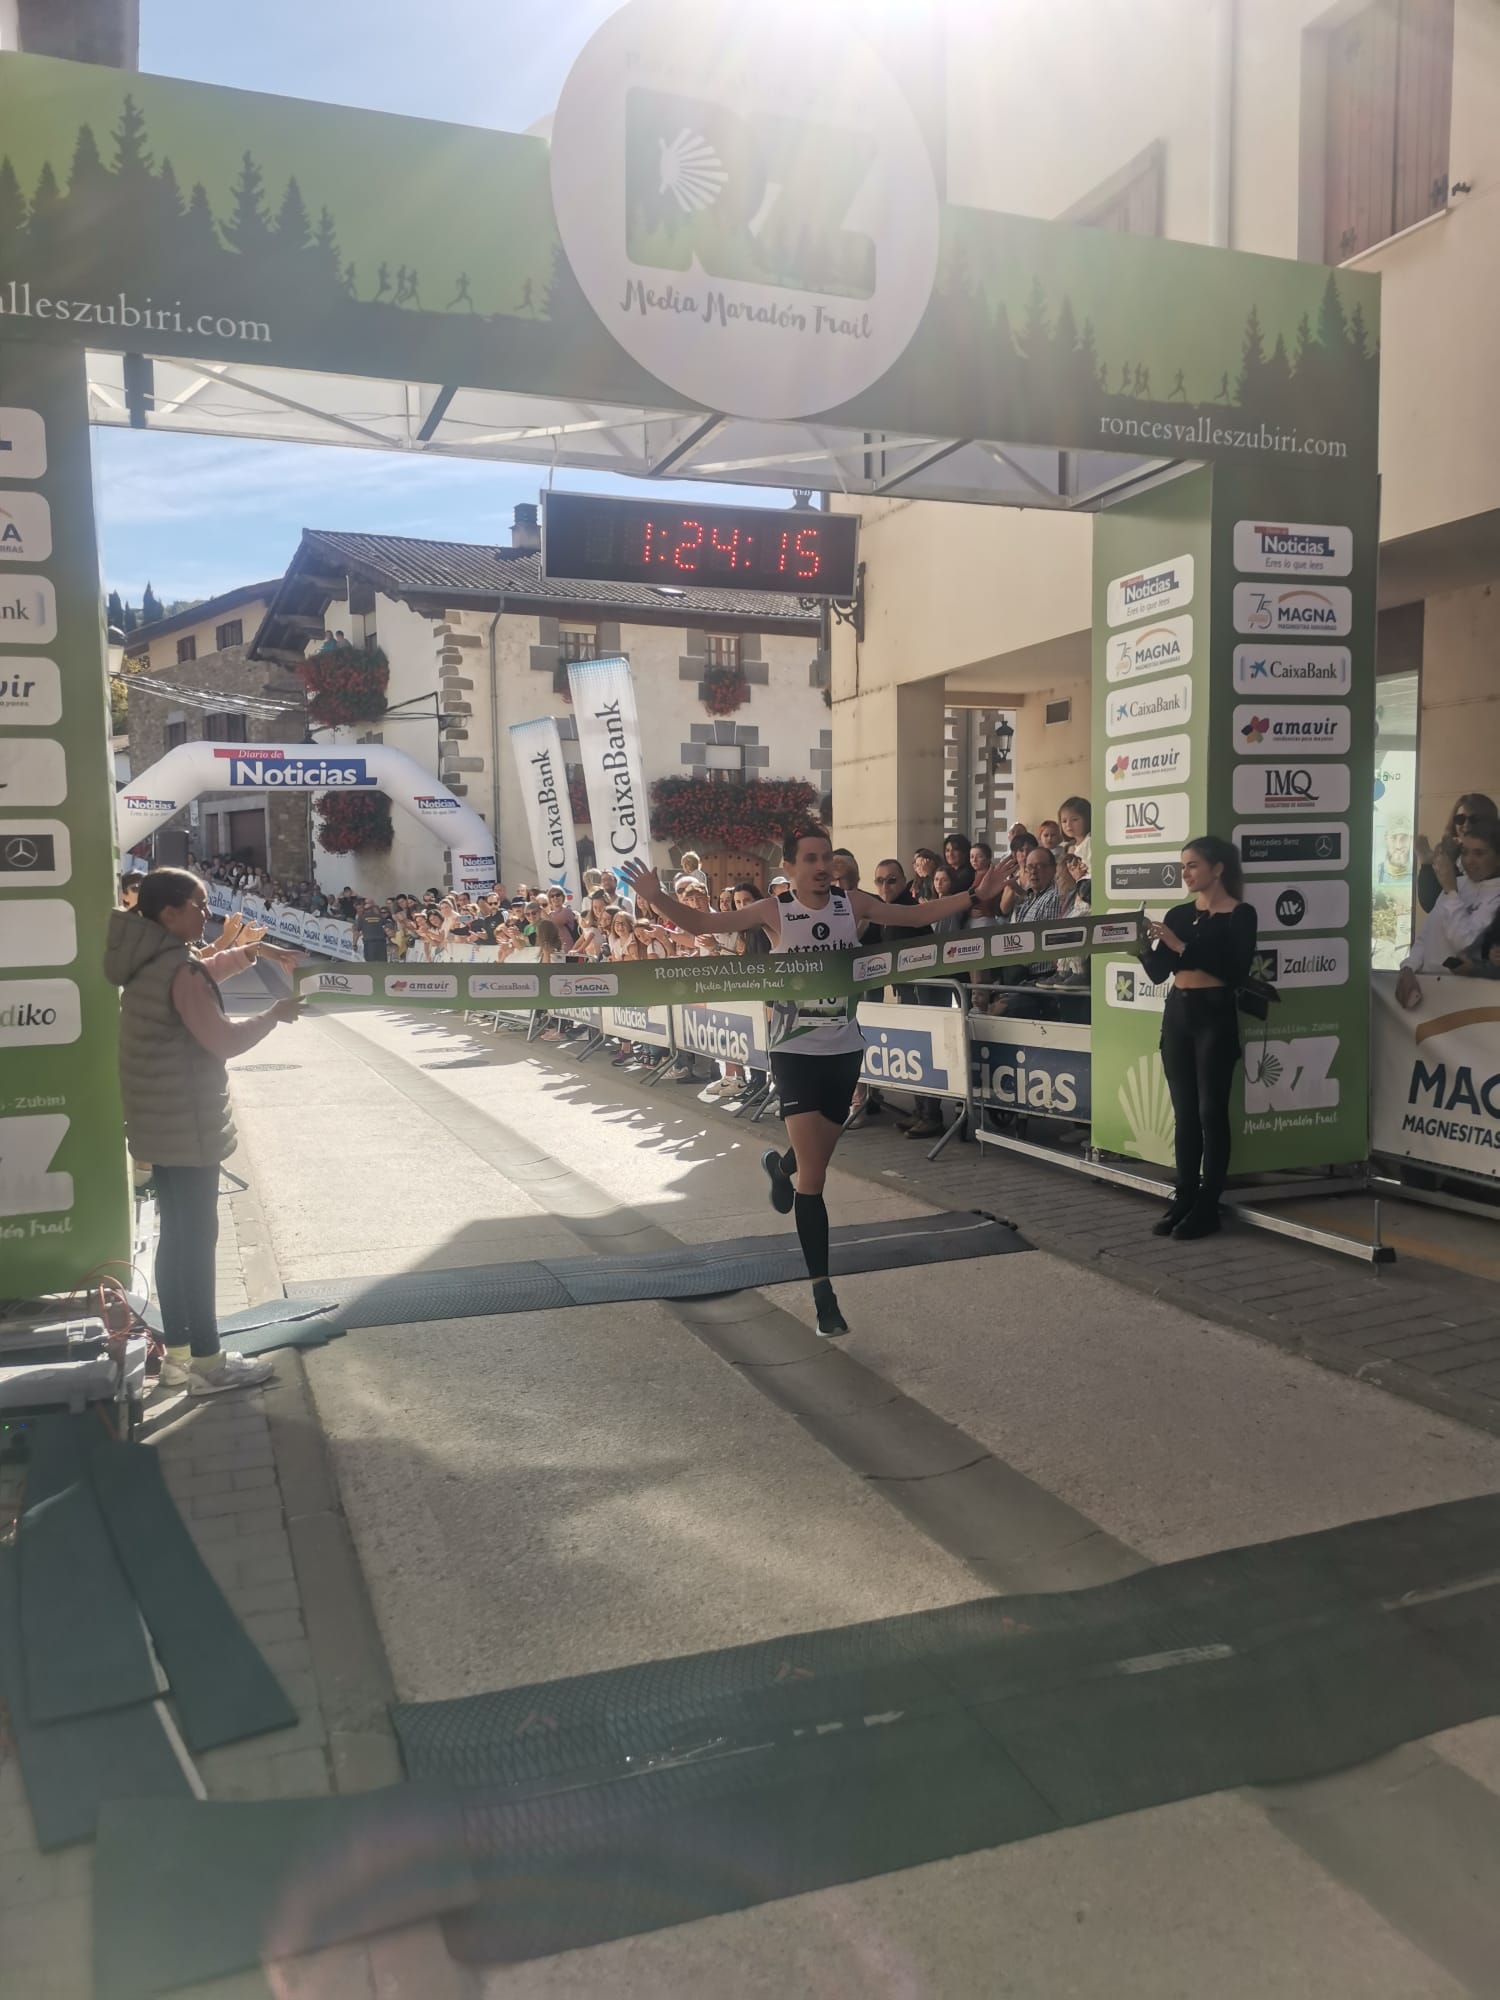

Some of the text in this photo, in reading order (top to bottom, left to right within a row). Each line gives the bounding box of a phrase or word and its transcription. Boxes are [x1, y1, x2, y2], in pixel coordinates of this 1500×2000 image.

[0, 280, 272, 342] lleszubiri.com
[620, 279, 872, 339] Media Maratón Trail
[1100, 416, 1348, 457] roncesvalleszubiri.com
[643, 520, 820, 577] 1:24:15
[1264, 535, 1324, 555] Noticias
[1265, 557, 1282, 569] Eres
[1126, 577, 1171, 602] Noticias
[0, 598, 29, 621] nk
[1278, 607, 1337, 623] MAGNA
[1136, 640, 1181, 663] MAGNA
[1270, 660, 1338, 679] CaixaBank
[1129, 694, 1181, 717] CaixaBank
[1272, 717, 1338, 735] amavir
[238, 749, 283, 759] Diario de
[1131, 748, 1180, 771] amavir
[236, 761, 357, 785] Noticias
[594, 699, 638, 855] CaixaBank
[1264, 769, 1320, 801] IMQ
[129, 800, 172, 809] Noticias
[420, 799, 456, 808] Noticias
[531, 749, 566, 869] CaixaBank
[1126, 802, 1165, 830] IMQ
[279, 921, 301, 935] MAGNA
[957, 944, 981, 953] amavir
[1003, 935, 1024, 948] IMQ
[654, 959, 824, 980] Roncesvalles Zubiri
[1283, 955, 1337, 974] Zaldiko
[319, 975, 351, 989] IMQ
[409, 981, 449, 990] amavir
[489, 982, 531, 991] CaixaBank
[575, 984, 610, 992] MAGNA
[614, 1006, 647, 1030] Noticias
[684, 1009, 749, 1063] Noticias
